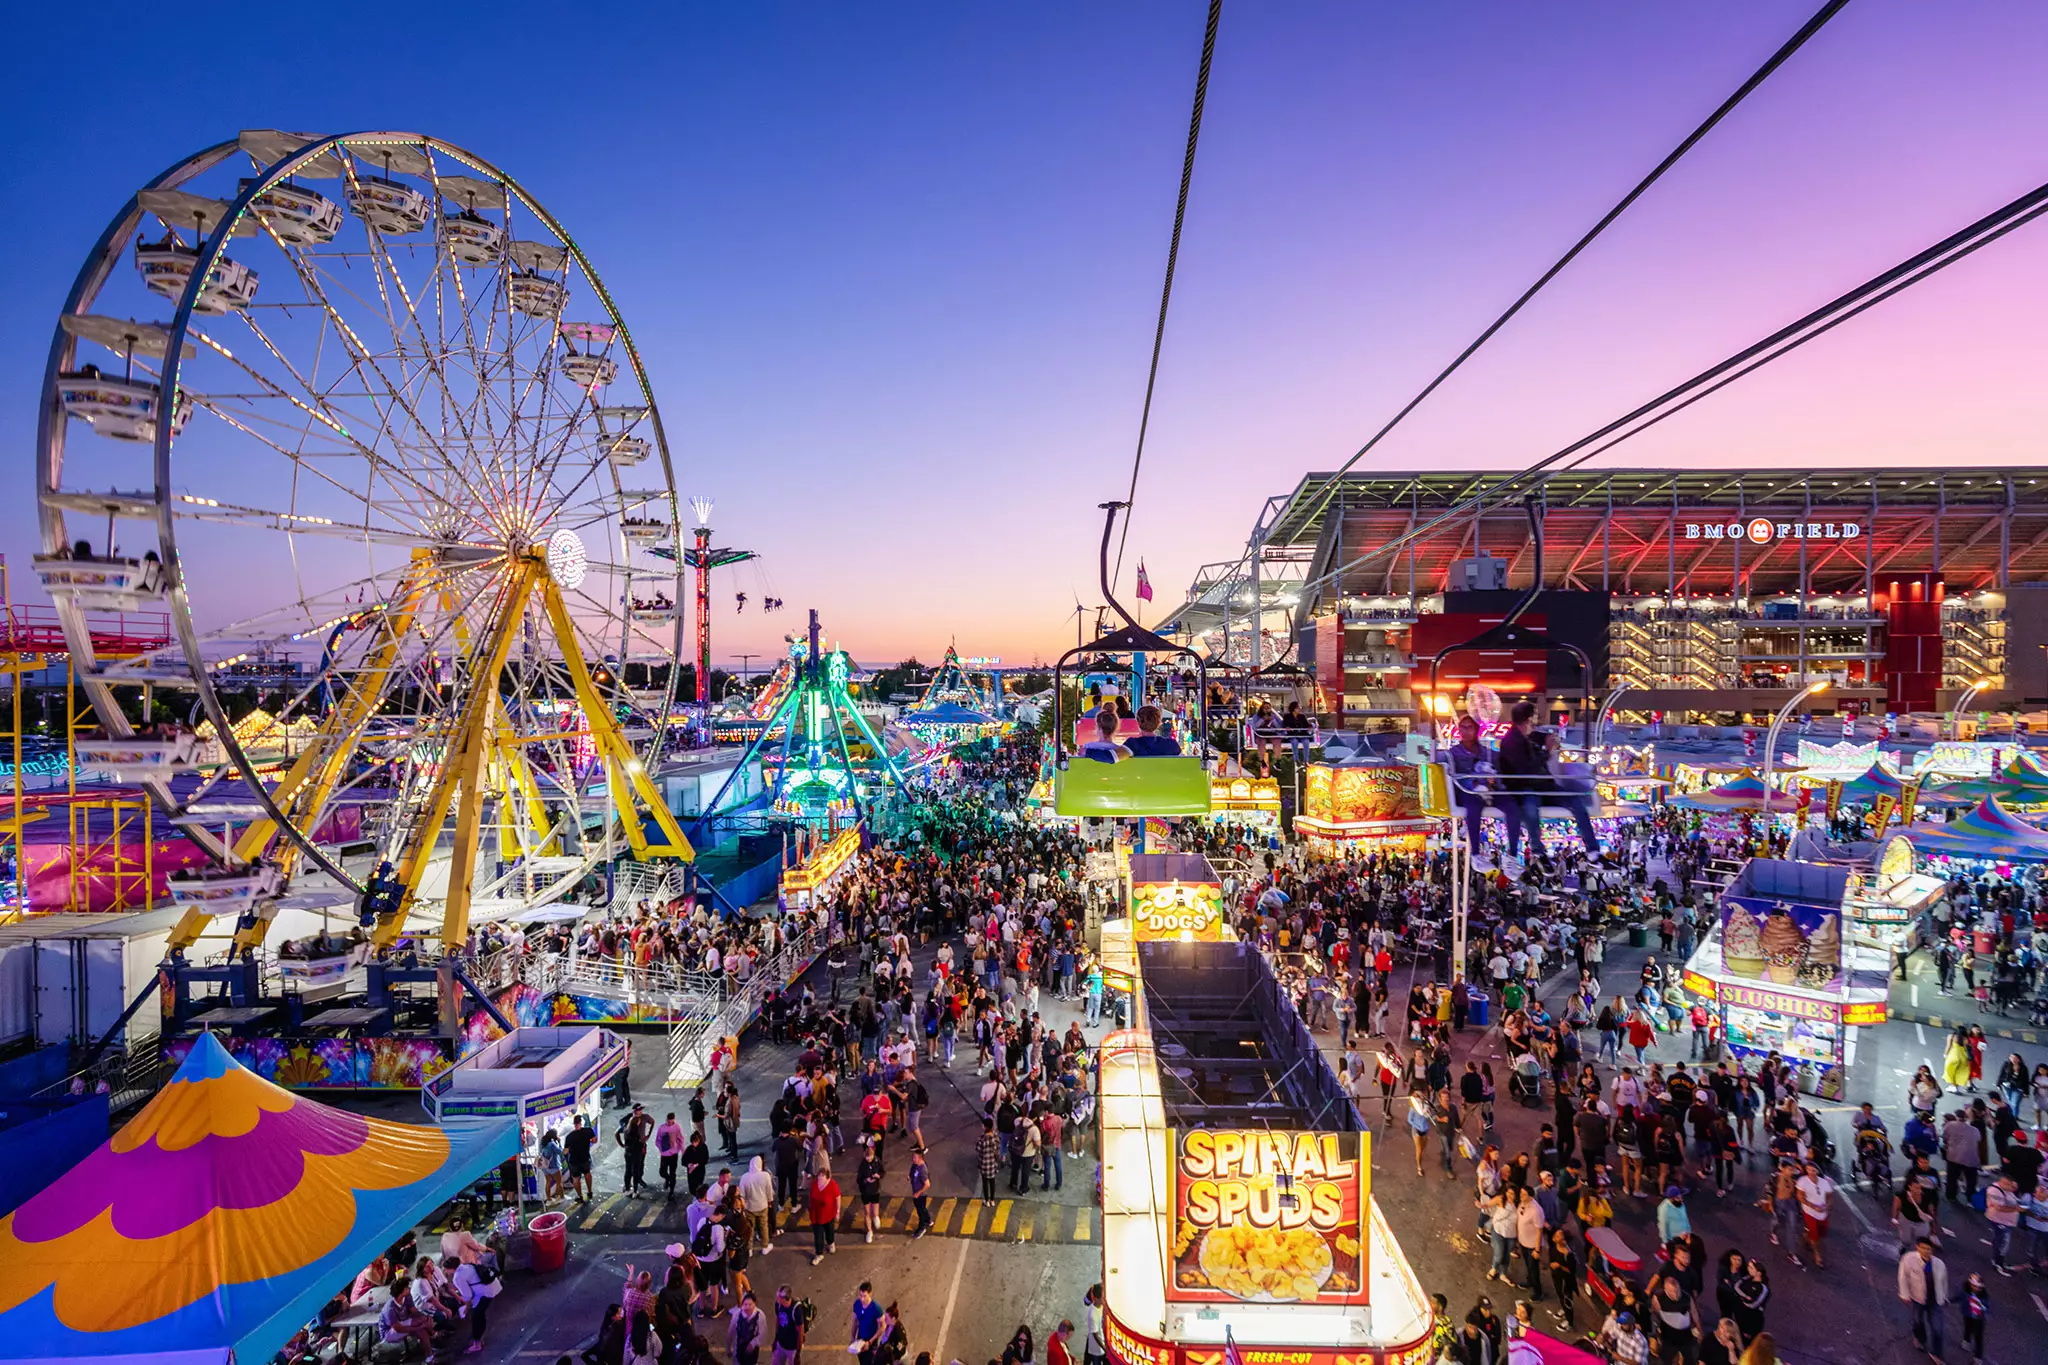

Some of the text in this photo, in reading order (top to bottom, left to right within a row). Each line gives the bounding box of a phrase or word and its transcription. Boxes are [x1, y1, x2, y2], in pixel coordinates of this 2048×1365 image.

[1686, 523, 1860, 539] BMO FIELD
[1862, 701, 1869, 712] 2
[1441, 722, 1513, 738] HPS
[1358, 768, 1403, 784] WINGS
[1364, 784, 1397, 796] FRIES
[1135, 884, 1219, 923] CORN
[1149, 914, 1206, 931] DOGS
[1722, 985, 1834, 1021] SLUSHIES
[1182, 1131, 1354, 1180] SPIRAL
[1186, 1180, 1345, 1229] SPUDS
[1109, 1320, 1156, 1363] SPIRAL
[1246, 1352, 1313, 1364] FRESH-CUT
